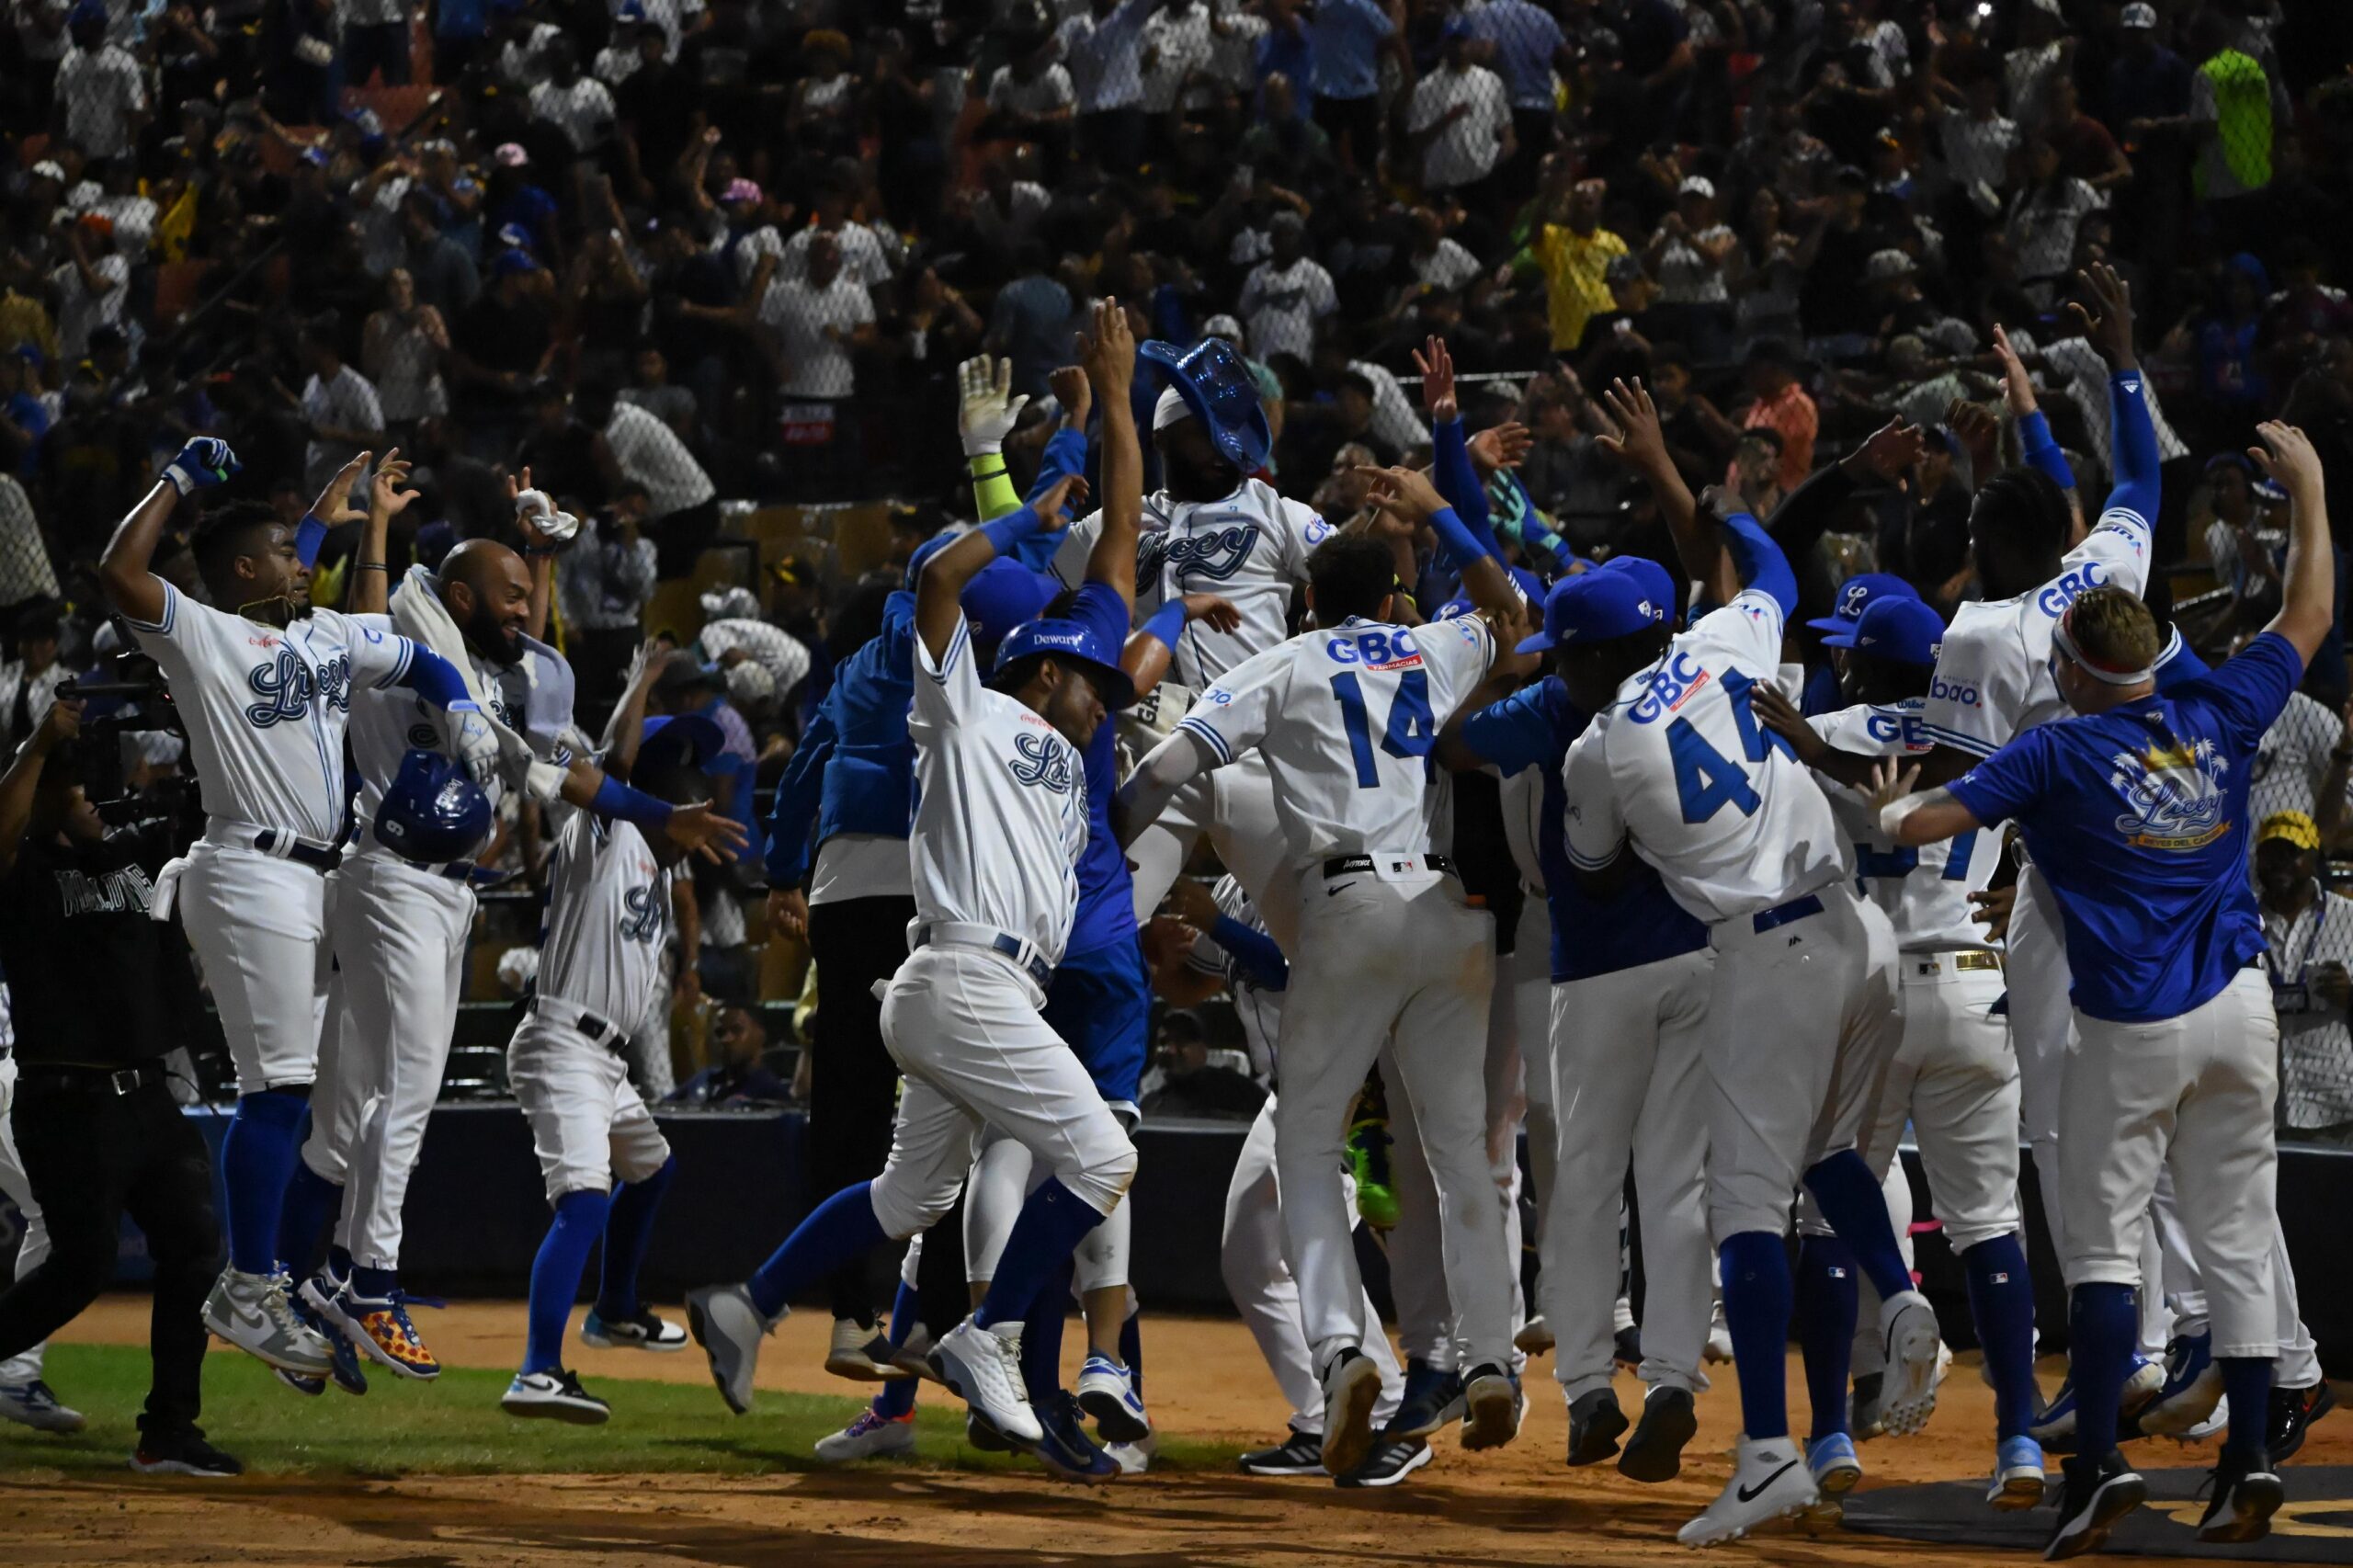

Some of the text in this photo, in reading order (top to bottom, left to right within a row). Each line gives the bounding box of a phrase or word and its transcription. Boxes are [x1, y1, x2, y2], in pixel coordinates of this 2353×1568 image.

[1326, 630, 1419, 665] GBC
[1372, 658, 1419, 671] FARMACIAS
[1628, 652, 1703, 724] GBC
[1329, 668, 1438, 789] 14
[2115, 777, 2229, 835] Licey
